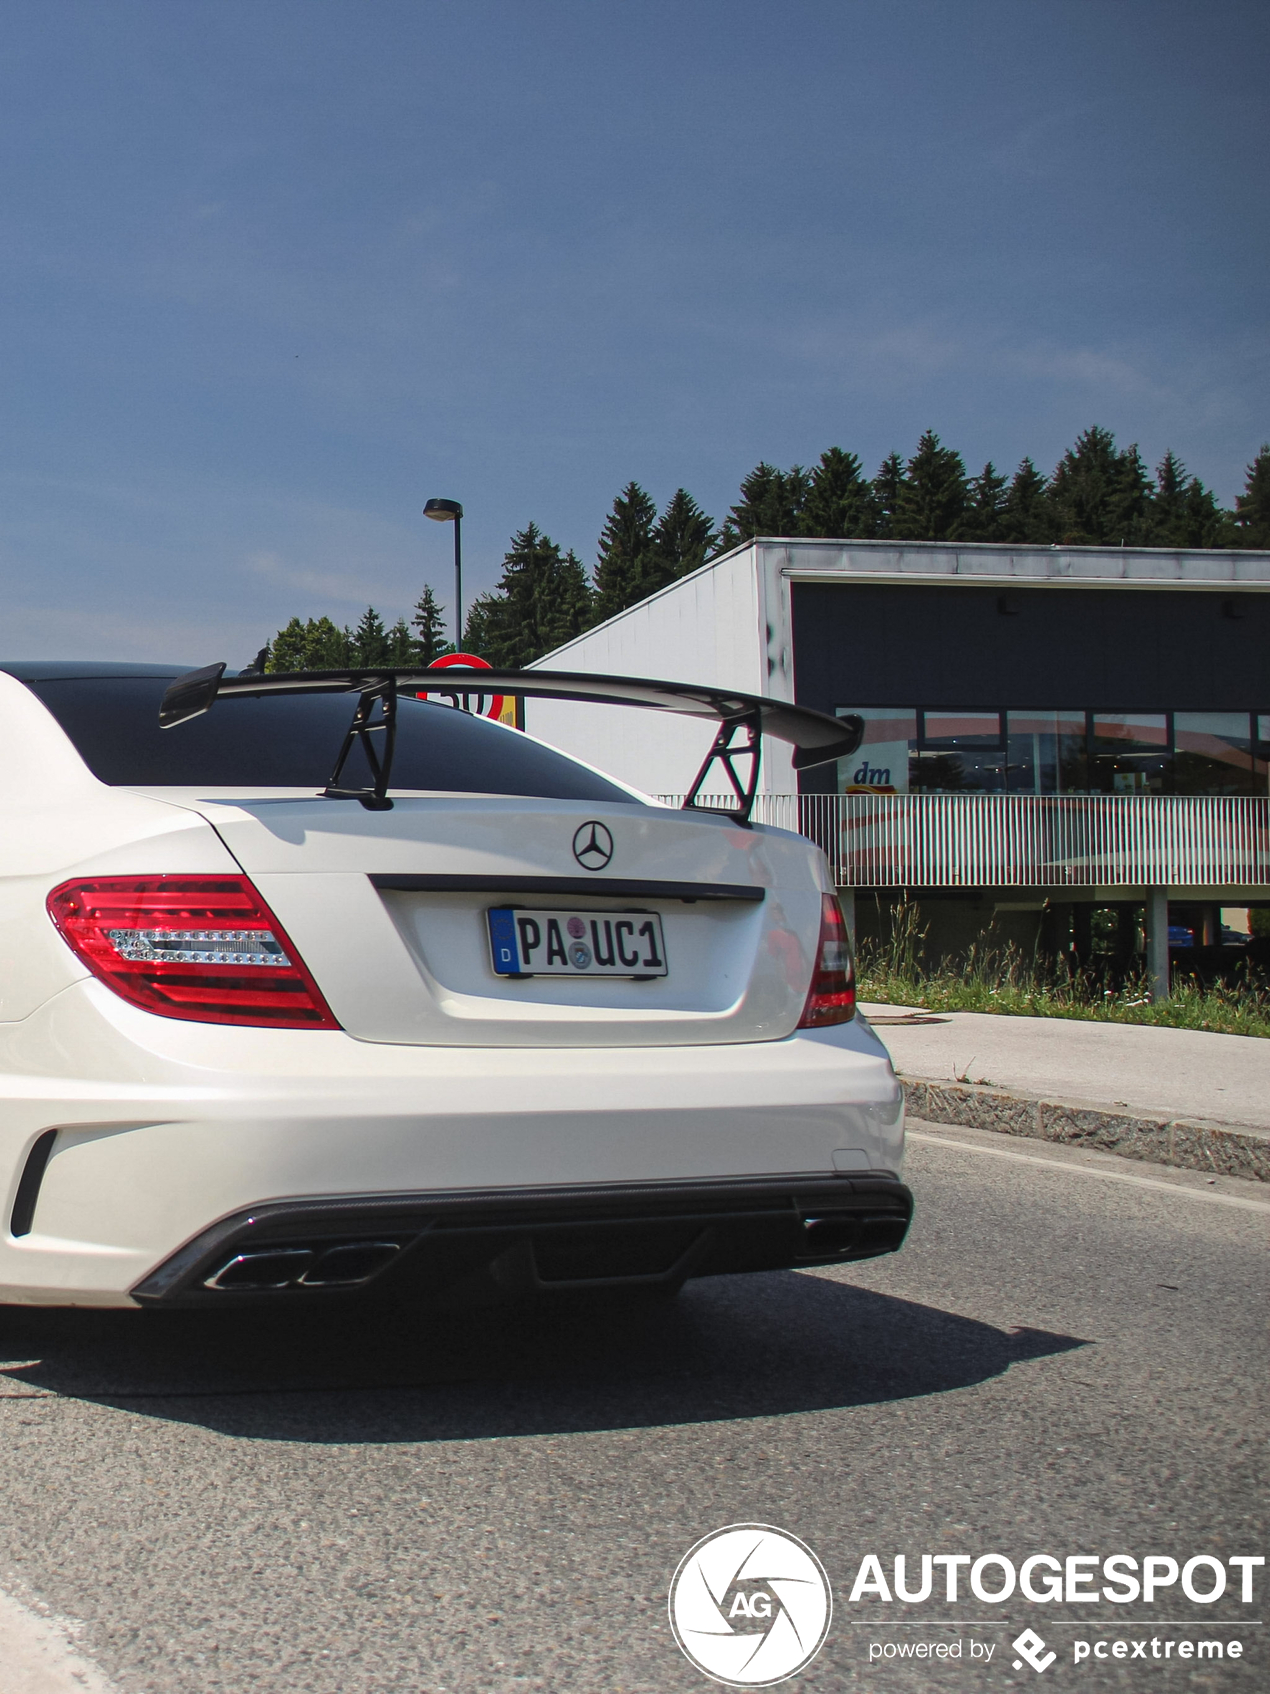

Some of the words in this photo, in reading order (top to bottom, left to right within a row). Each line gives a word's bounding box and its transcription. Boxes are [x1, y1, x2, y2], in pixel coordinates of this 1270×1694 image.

[853, 761, 891, 785] dm
[517, 917, 568, 965] PA
[590, 919, 662, 967] UC1
